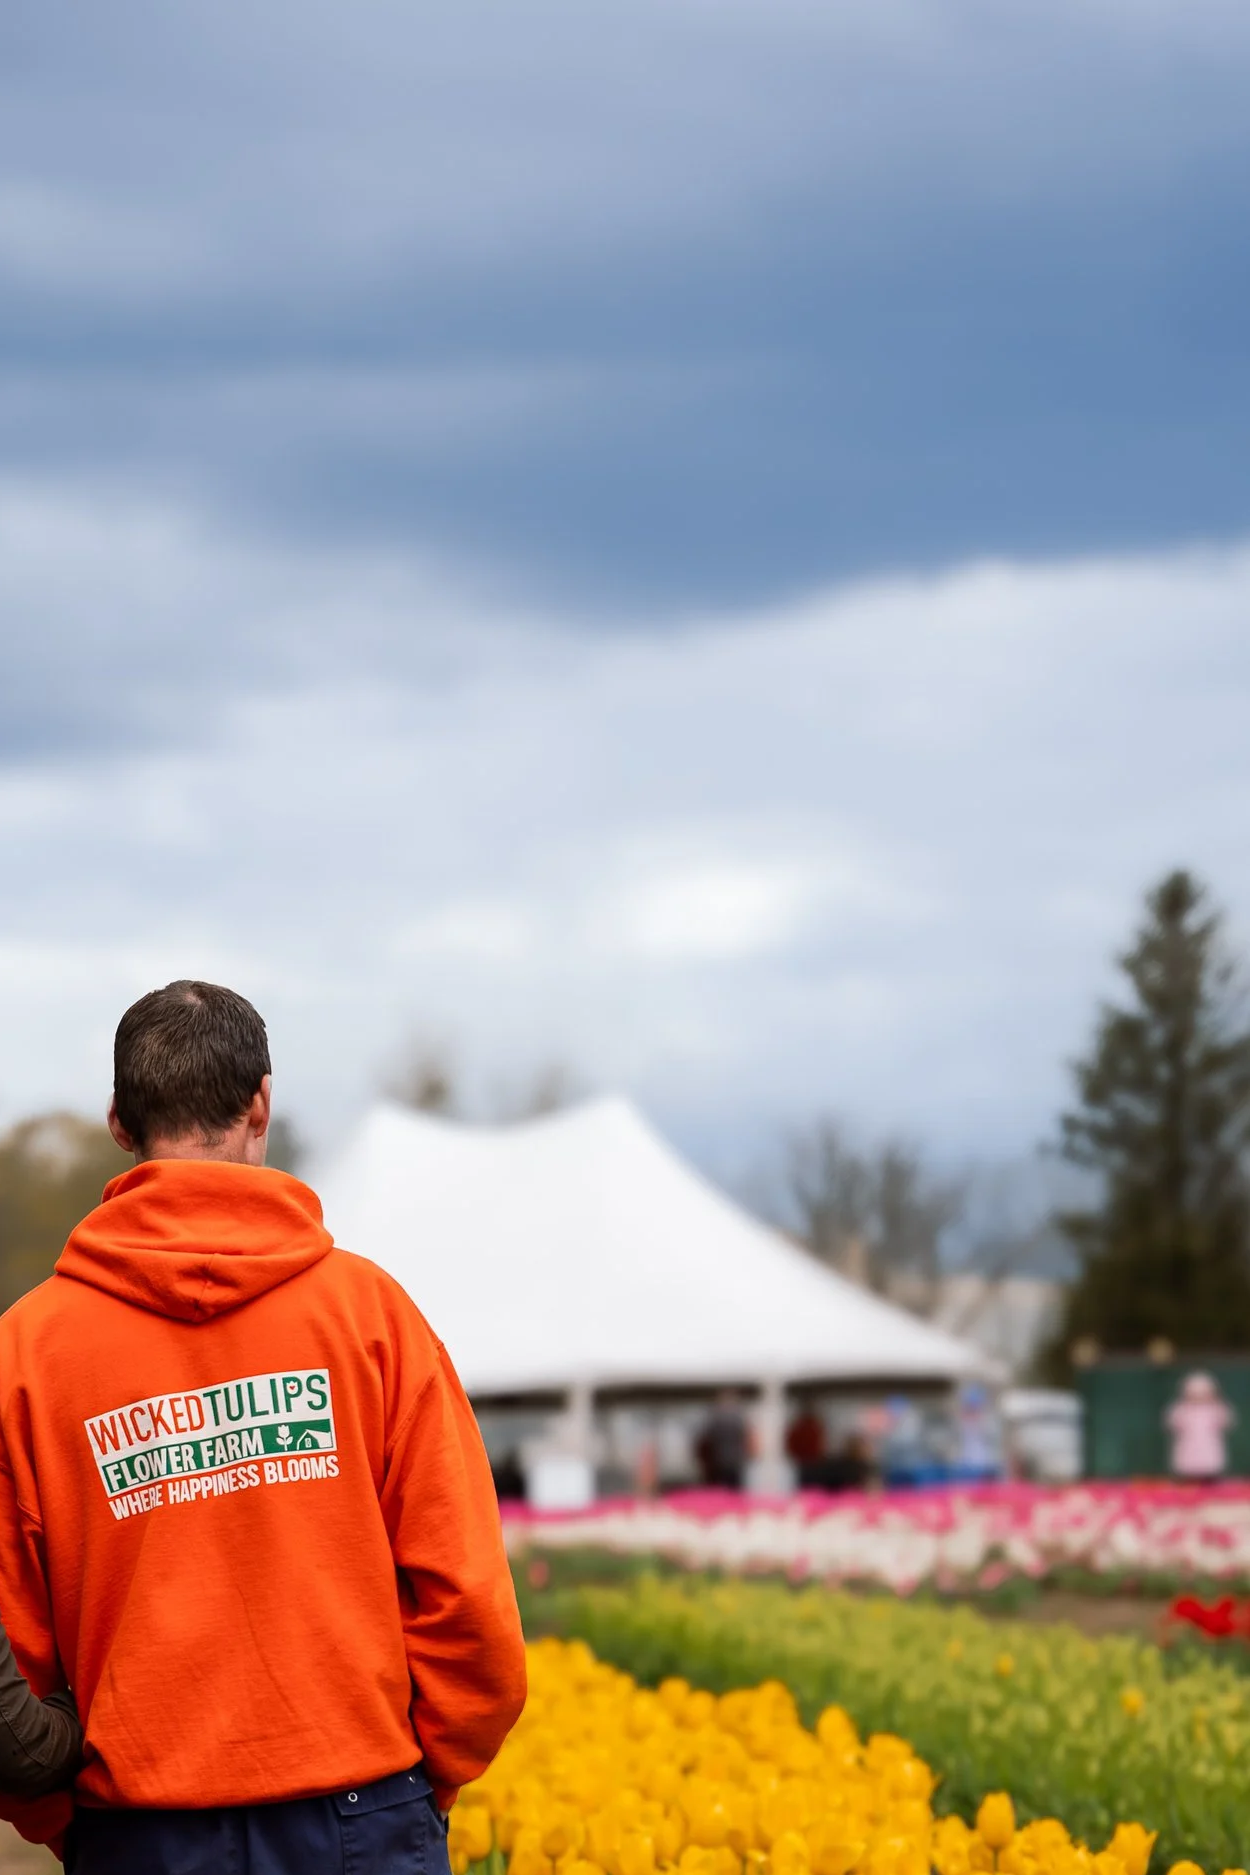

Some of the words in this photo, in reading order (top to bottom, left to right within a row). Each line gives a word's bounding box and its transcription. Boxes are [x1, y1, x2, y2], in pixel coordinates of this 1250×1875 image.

[104, 1444, 197, 1492] FLOWER
[202, 1428, 265, 1468] FARM
[108, 1485, 163, 1520] WHERE
[168, 1464, 260, 1504] HAPPINESS
[264, 1455, 340, 1484] BLOOMS
